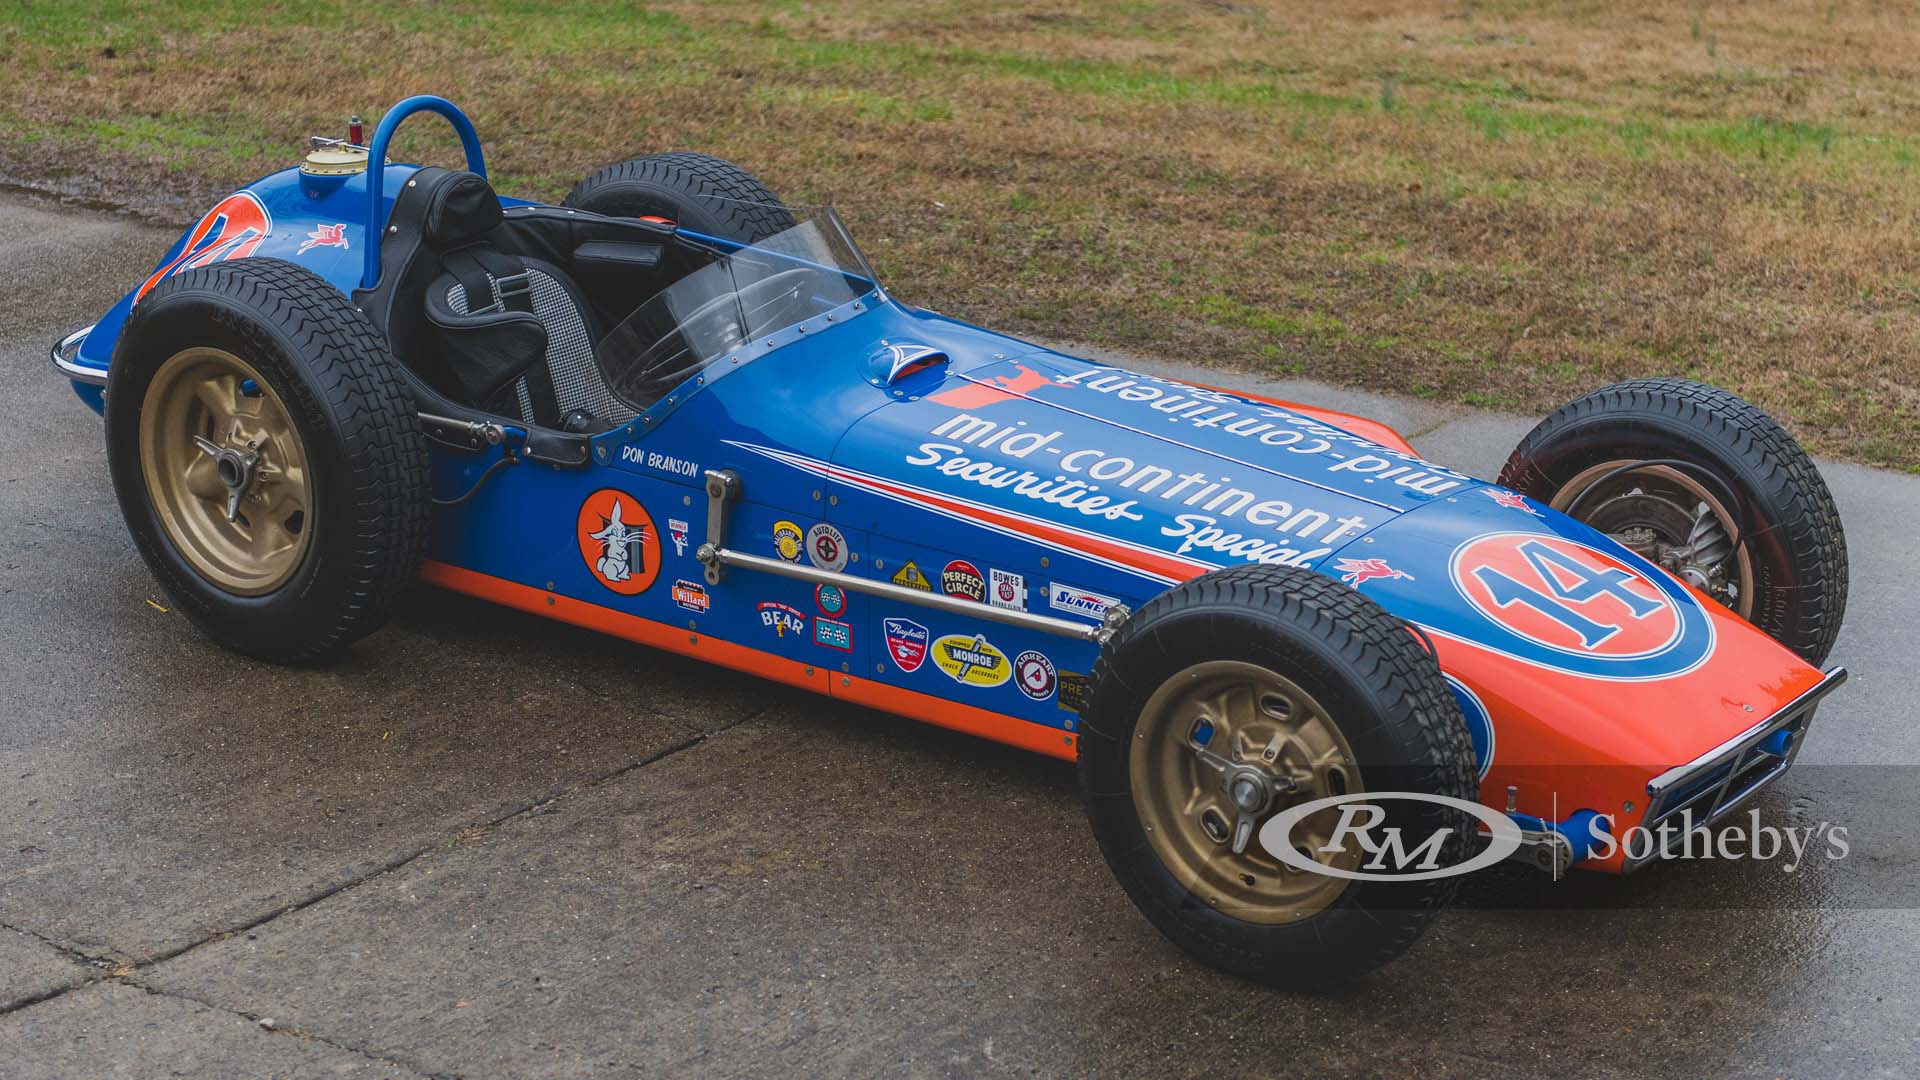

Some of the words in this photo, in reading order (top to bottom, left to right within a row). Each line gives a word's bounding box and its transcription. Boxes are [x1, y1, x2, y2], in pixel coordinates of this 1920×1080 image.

[1056, 366, 1463, 496] mid-continent
[622, 445, 645, 465] DON
[647, 452, 699, 478] BRANSON
[931, 413, 1368, 545] mid-continent
[905, 442, 1144, 522] Securities
[1160, 513, 1333, 568] Special
[813, 525, 842, 544] AUTOLITE
[943, 570, 985, 591] PERFECT
[993, 571, 1020, 587] BOWES
[677, 589, 706, 607] Willard
[945, 582, 981, 600] CIRCLE
[1471, 539, 1667, 651] 14
[761, 611, 804, 636] BEAR
[889, 622, 926, 640] Raybestos
[952, 648, 993, 667] MONROE
[1017, 653, 1055, 677] AIRHEART
[1060, 680, 1084, 696] PRE
